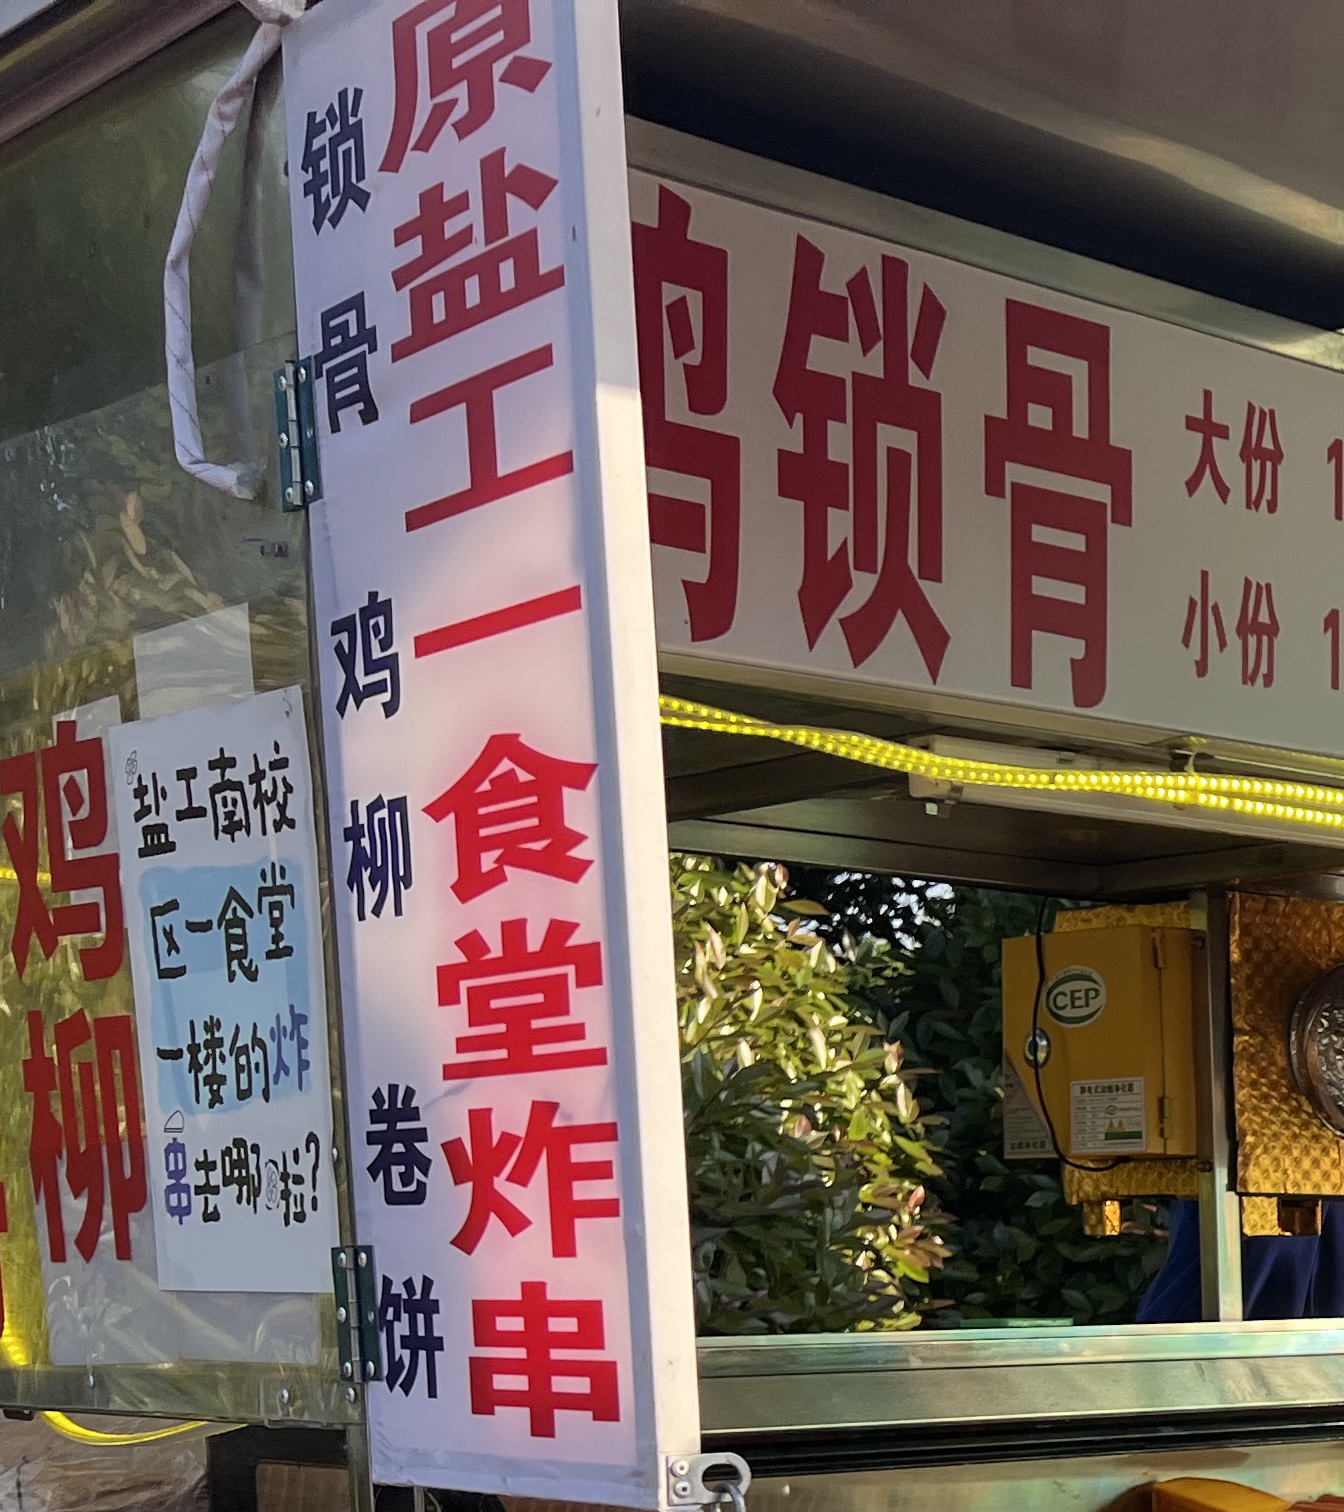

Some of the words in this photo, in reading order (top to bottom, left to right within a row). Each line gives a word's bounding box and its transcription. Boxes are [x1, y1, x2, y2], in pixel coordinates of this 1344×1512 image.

[300, 86, 379, 433] 锁骨
[1184, 388, 1284, 515] 大份
[1181, 569, 1281, 687] 小份
[329, 591, 413, 921] 鸡柳
[378, 0, 621, 1440] 原盐工一食堂炸串
[133, 740, 296, 858] 盐工南校
[150, 862, 295, 982] 区一食堂
[0, 720, 147, 1264] 鸡柳
[1053, 987, 1101, 1011] CEP
[156, 1004, 310, 1109] 一楼的炸
[366, 1082, 444, 1399] 卷饼
